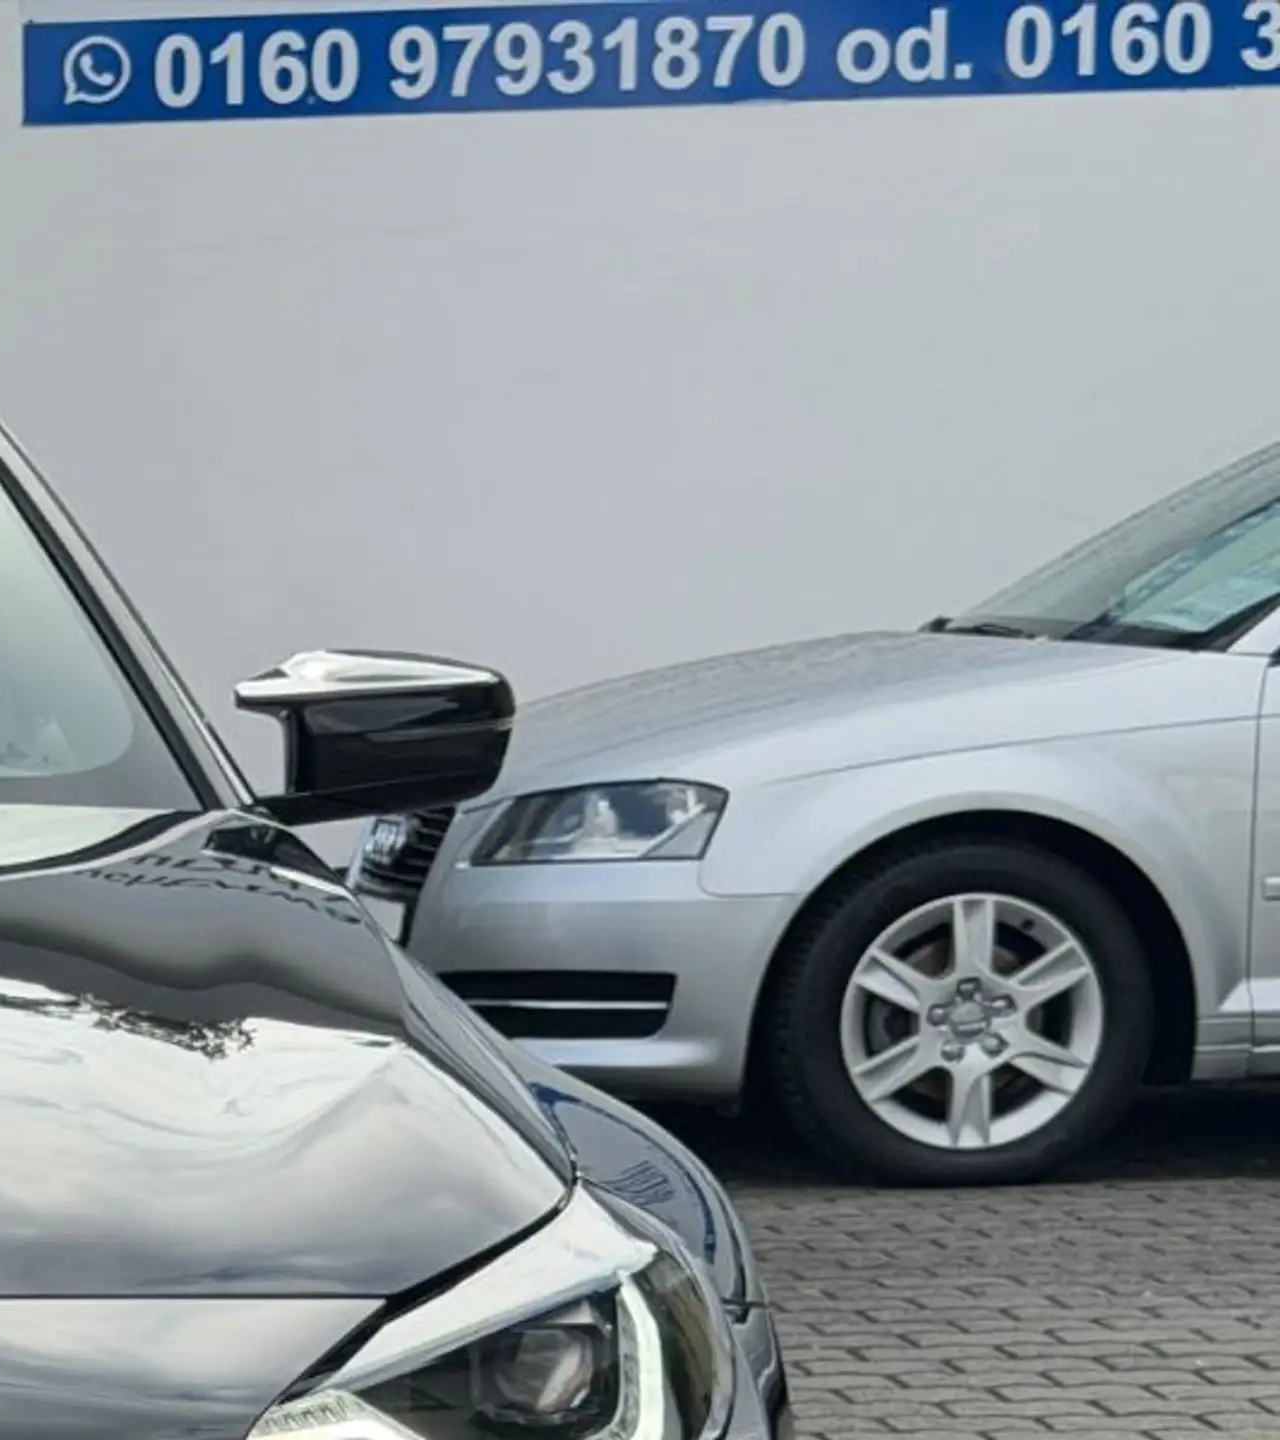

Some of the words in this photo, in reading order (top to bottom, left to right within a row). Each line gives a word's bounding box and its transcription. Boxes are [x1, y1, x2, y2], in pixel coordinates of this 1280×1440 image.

[153, 28, 360, 109] 0160
[388, 12, 806, 98] 97931870
[837, 7, 972, 84] od.
[1004, 1, 1212, 79] 0160
[1240, 1, 1280, 72] 3
